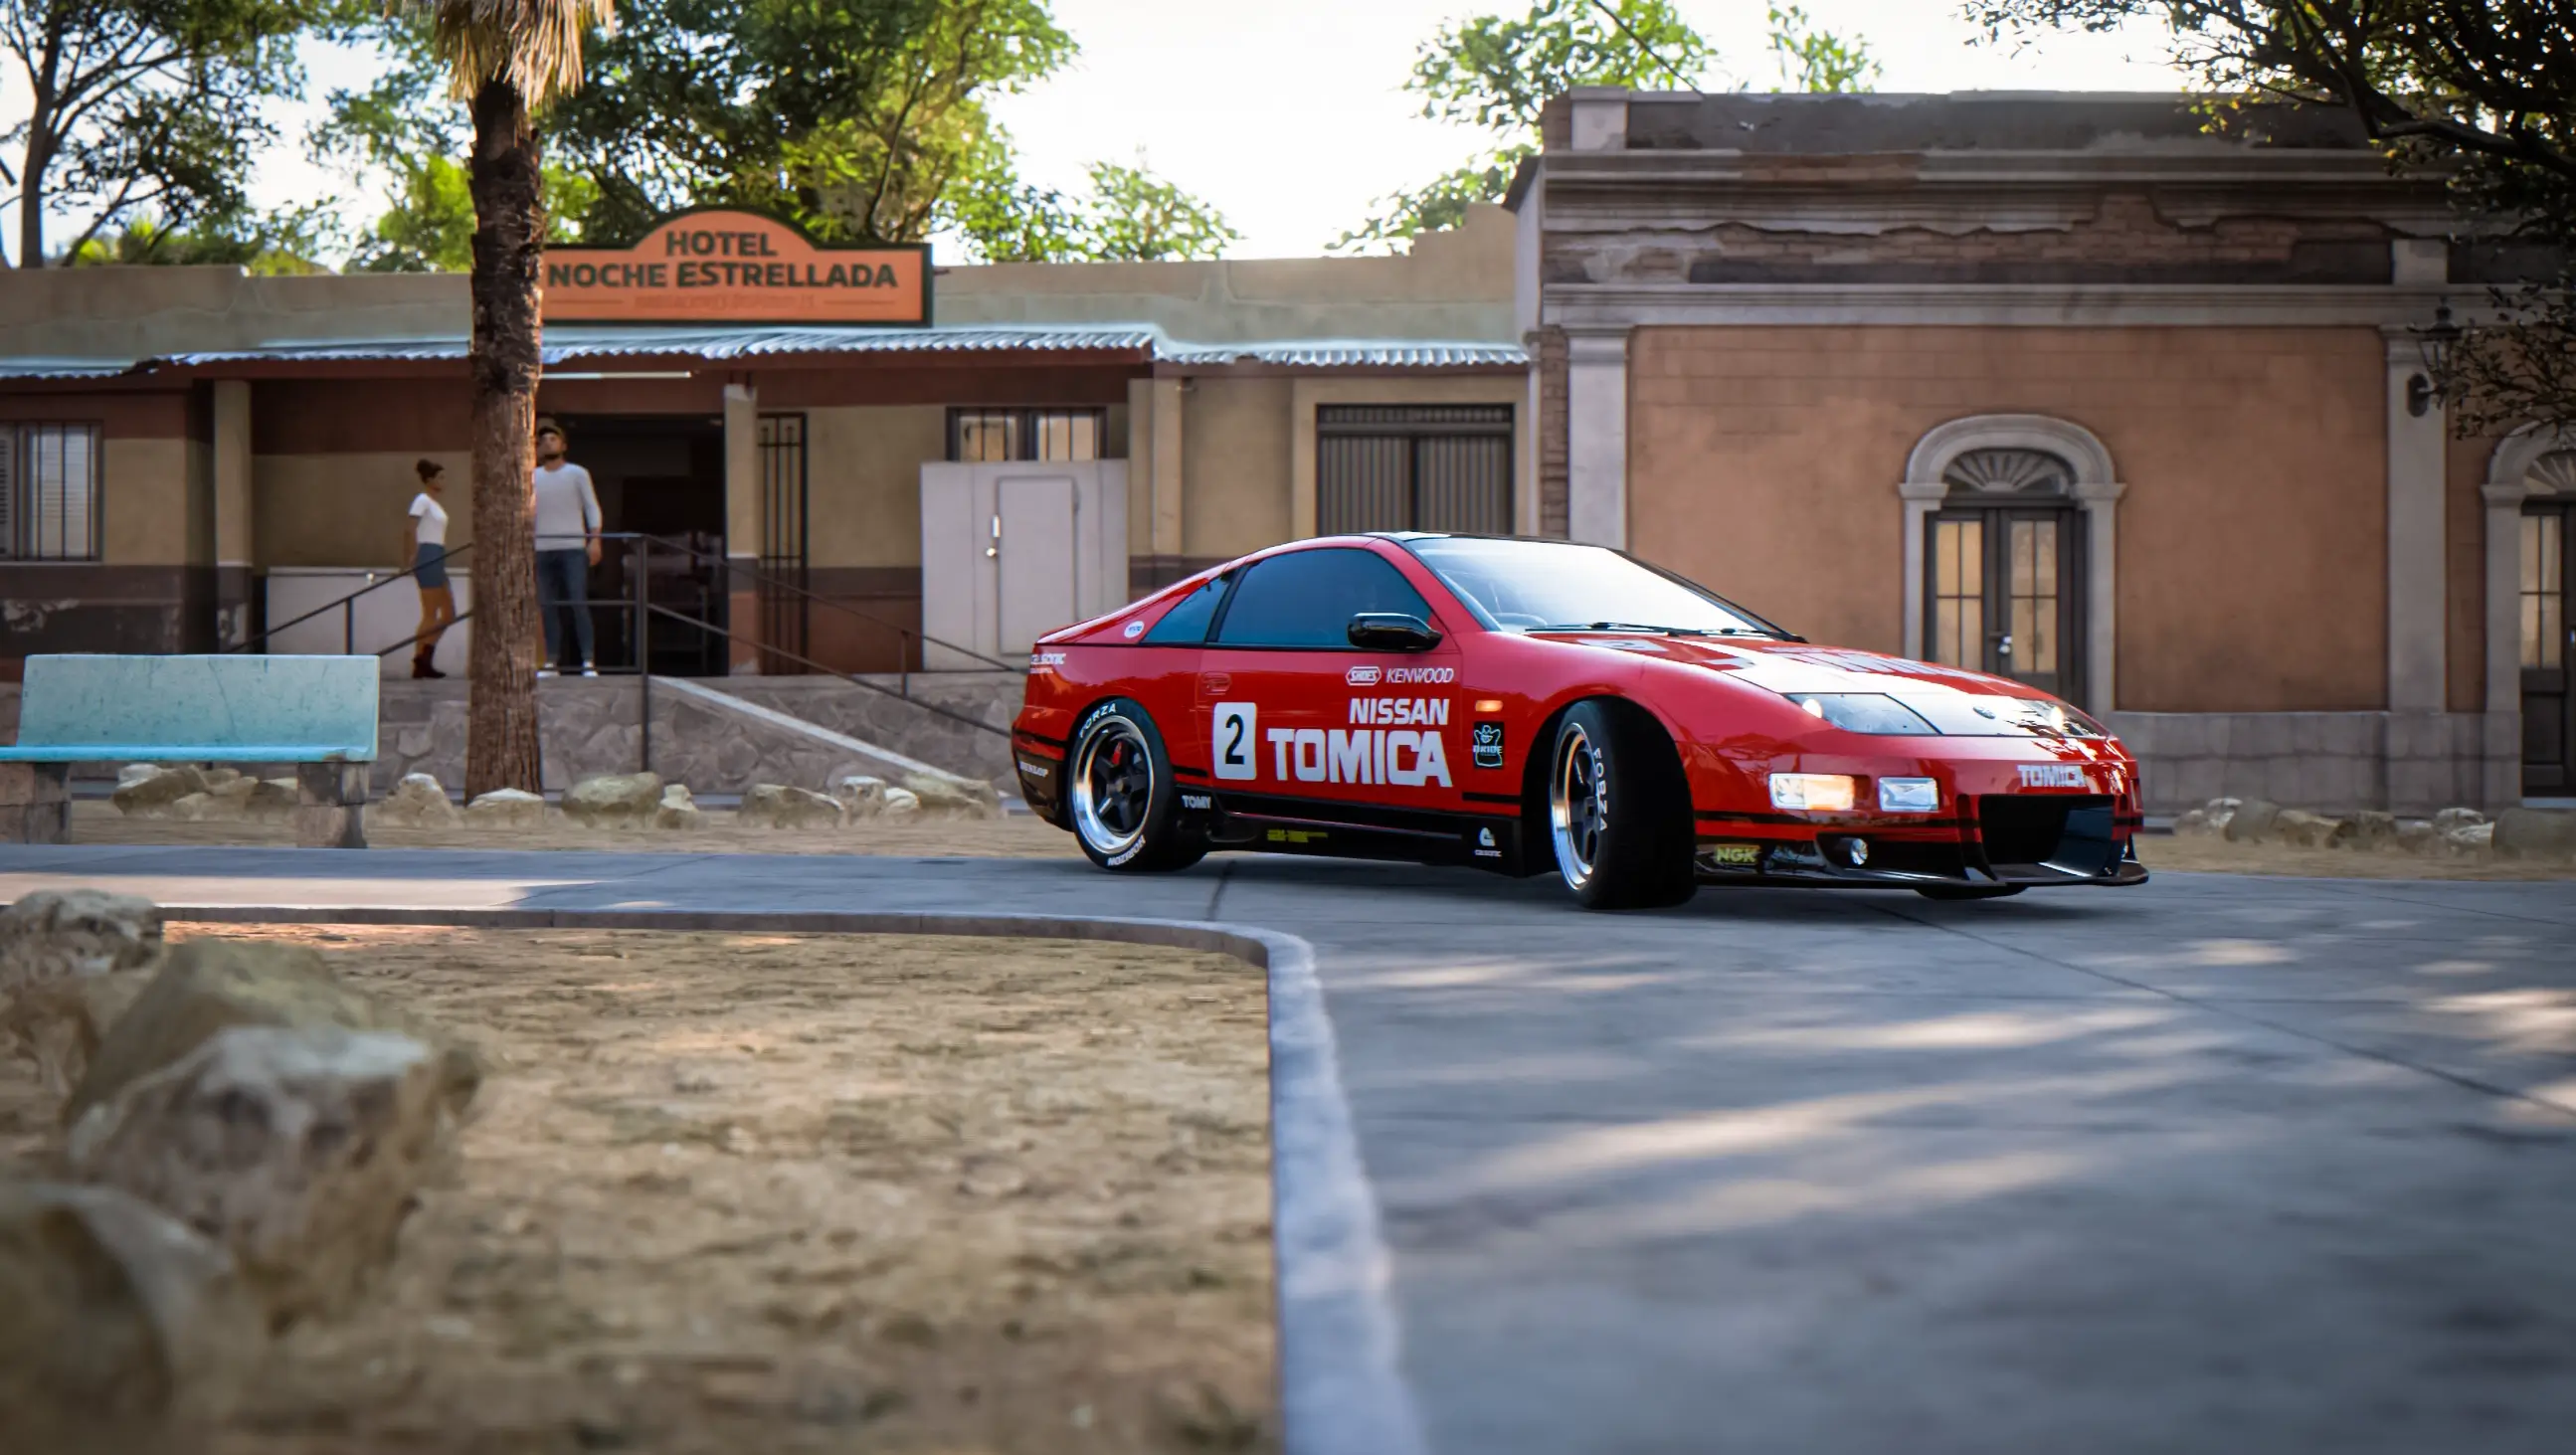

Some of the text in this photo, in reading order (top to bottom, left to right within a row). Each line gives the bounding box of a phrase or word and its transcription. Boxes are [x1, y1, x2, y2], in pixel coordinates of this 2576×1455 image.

[665, 230, 778, 258] HOTEL
[547, 261, 898, 288] NOCHE ESTRELLADA
[1385, 667, 1455, 684] KENWOOD
[1079, 702, 1117, 738] FORZA
[1349, 697, 1450, 726] NISSAN
[1224, 713, 1245, 765] 2
[1266, 727, 1453, 788] TOMICA
[2016, 764, 2087, 788] TOMICA
[1716, 846, 1758, 863] NGK
